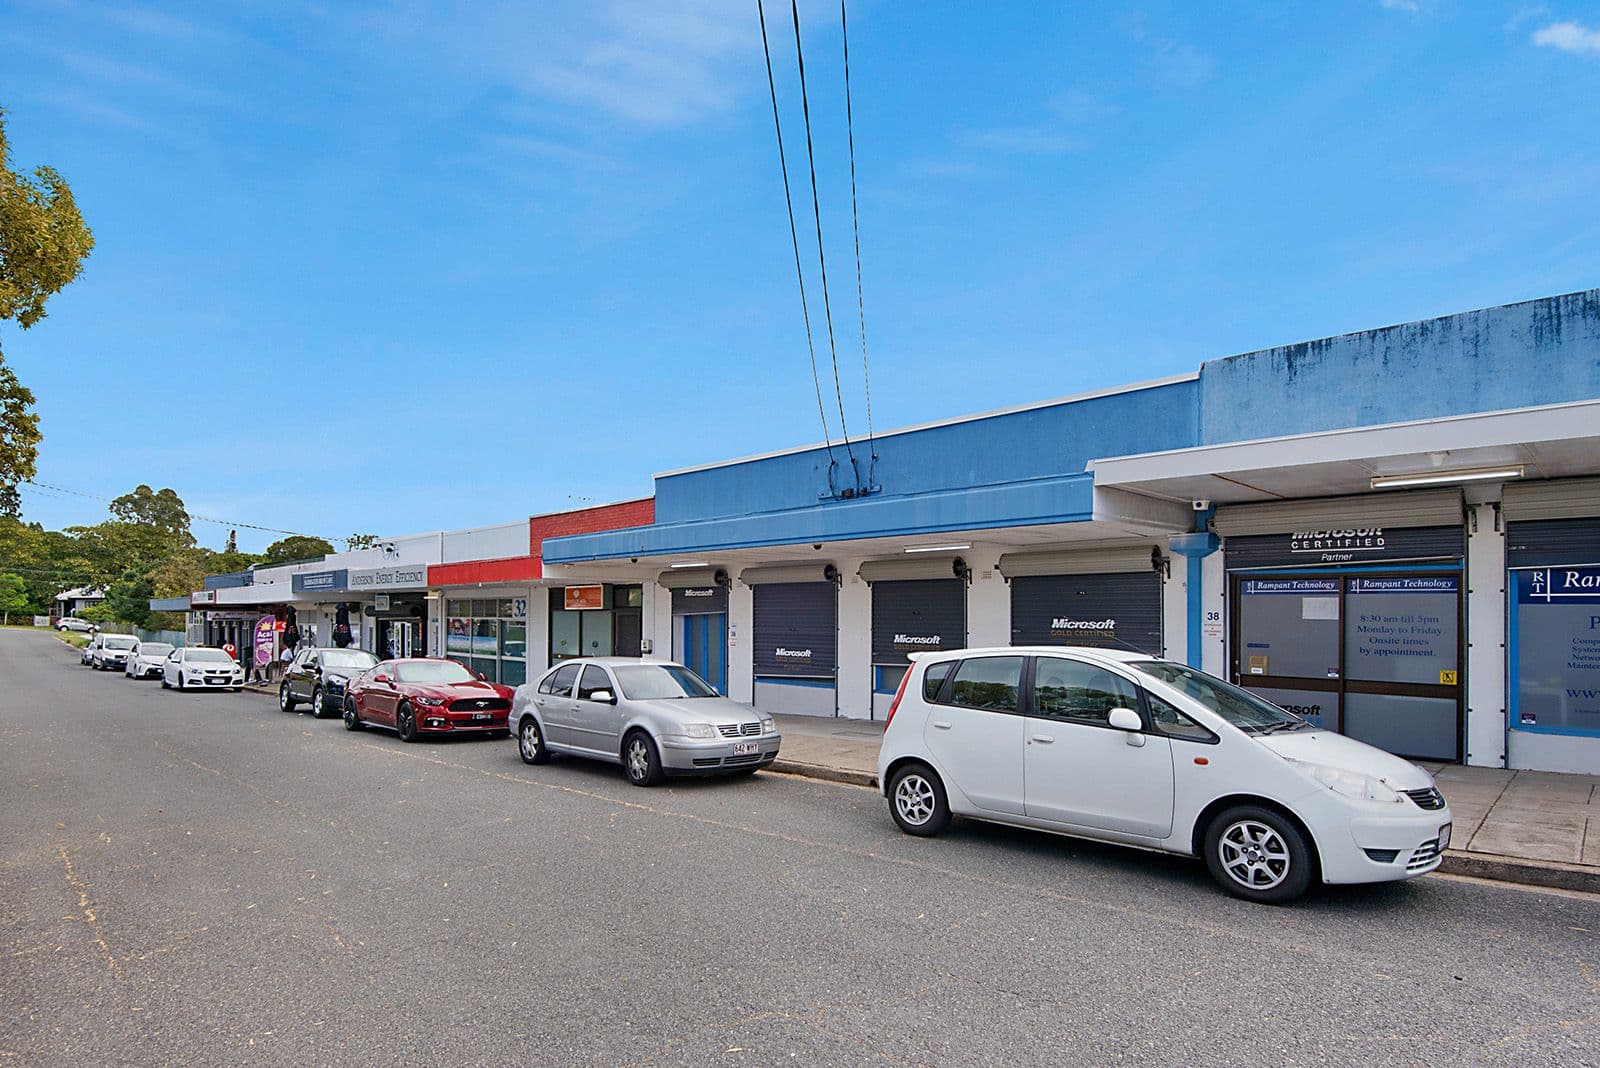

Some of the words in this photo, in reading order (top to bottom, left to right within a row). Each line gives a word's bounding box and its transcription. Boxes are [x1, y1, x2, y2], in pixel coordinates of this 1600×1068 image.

[1291, 538, 1385, 549] CERTIFIED
[1321, 553, 1353, 561] Partner
[1292, 581, 1335, 589] Technology
[1363, 580, 1401, 588] Rampant
[1403, 579, 1452, 588] Technology
[514, 600, 527, 617] 32
[1207, 611, 1220, 621] 38
[1360, 614, 1381, 623] 8:30
[1051, 618, 1115, 629] Microsoft
[1357, 625, 1395, 635] Monday
[1411, 626, 1442, 637] Friday
[894, 634, 940, 645] Microsoft
[1369, 636, 1400, 645] Onsite
[1402, 637, 1430, 646] times
[776, 647, 811, 658] Microsoft
[1360, 647, 1370, 656] by
[1373, 648, 1437, 657] appointment.
